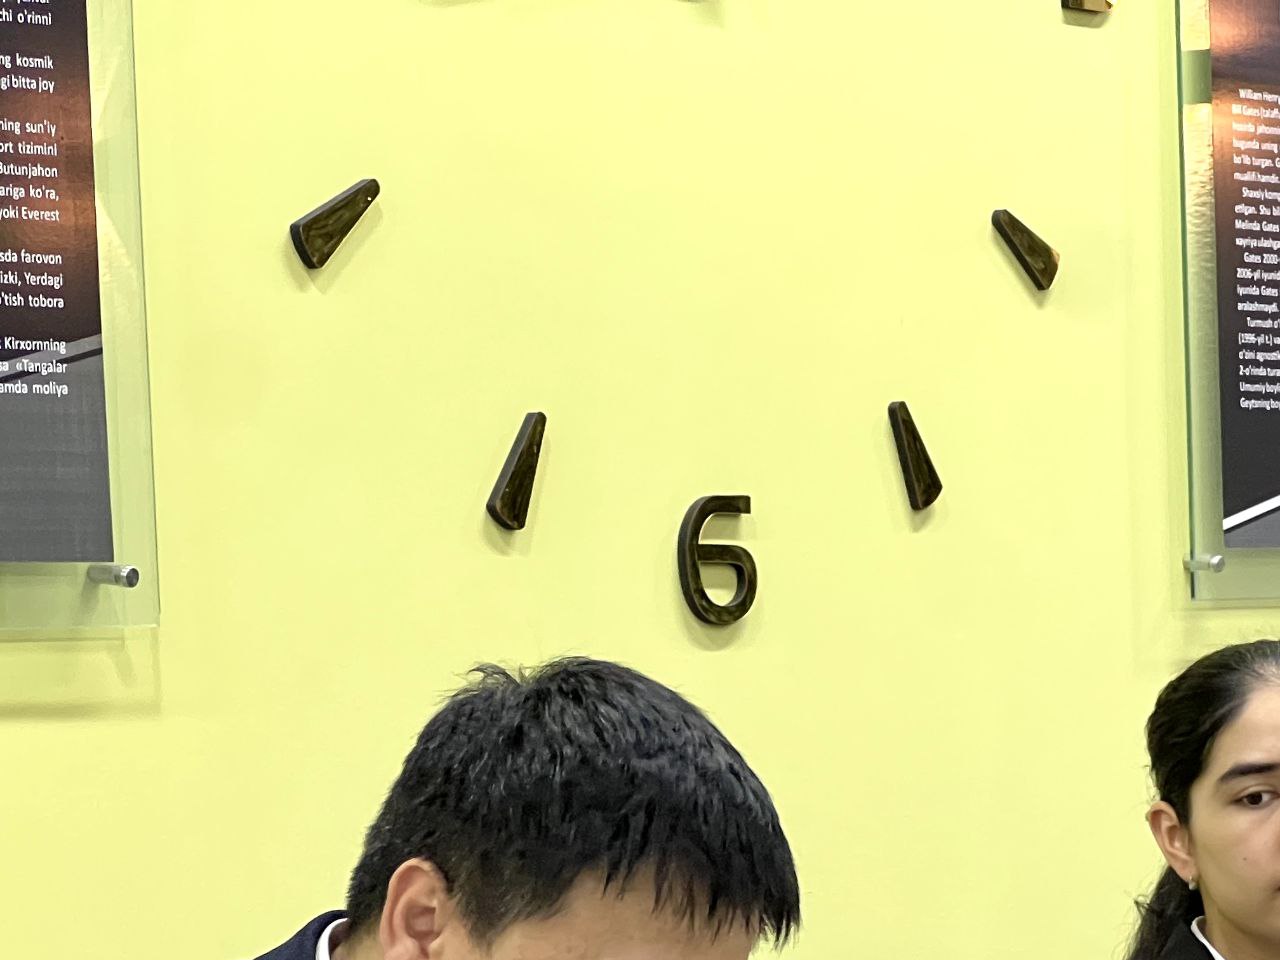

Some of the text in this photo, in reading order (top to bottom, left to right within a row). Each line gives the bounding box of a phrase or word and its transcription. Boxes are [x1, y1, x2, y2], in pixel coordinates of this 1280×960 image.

[18, 10, 52, 25] o'rinni
[16, 53, 54, 70] kosmik
[12, 75, 36, 89] bitta
[38, 78, 55, 94] joy
[26, 120, 56, 137] sun'iy
[18, 142, 57, 156] tizimini
[30, 185, 59, 201] ko'ra,
[21, 207, 60, 221] Everest
[21, 249, 62, 265] farovon
[24, 272, 63, 289] Yerdagi
[29, 294, 65, 308] tobora
[33, 382, 68, 397] moliya
[678, 495, 757, 624] 6
